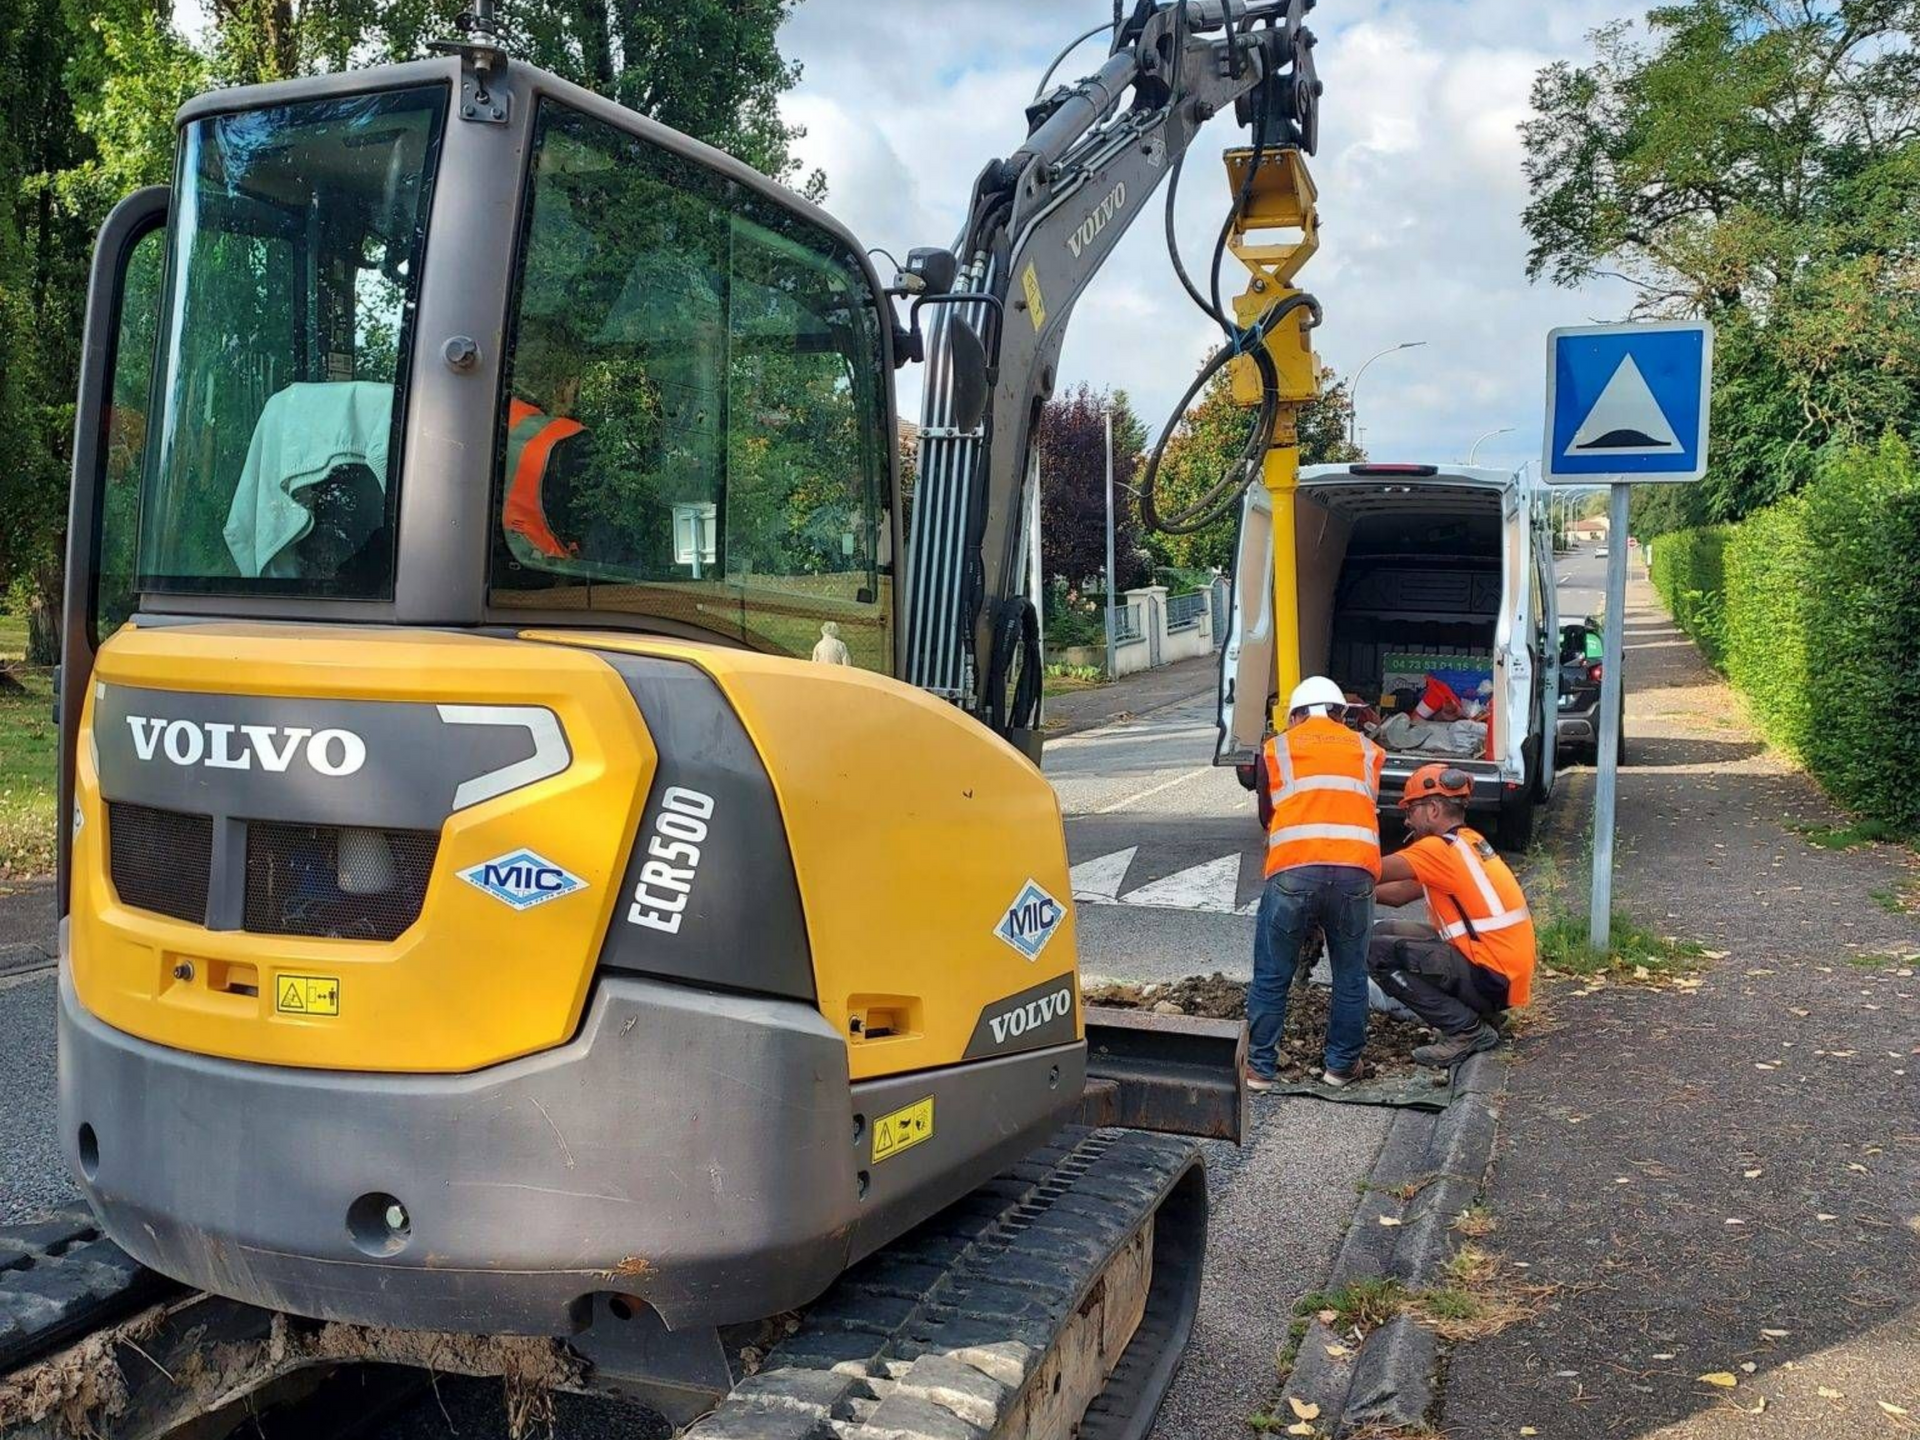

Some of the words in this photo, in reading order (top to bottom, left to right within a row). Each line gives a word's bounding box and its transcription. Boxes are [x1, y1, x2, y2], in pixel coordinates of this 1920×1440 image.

[1068, 182, 1125, 258] VOLVO
[126, 715, 366, 776] VOLVO
[483, 864, 563, 891] MIC
[627, 786, 714, 934] ECR50D
[1009, 898, 1054, 939] MIC
[989, 988, 1070, 1044] VOLVO
